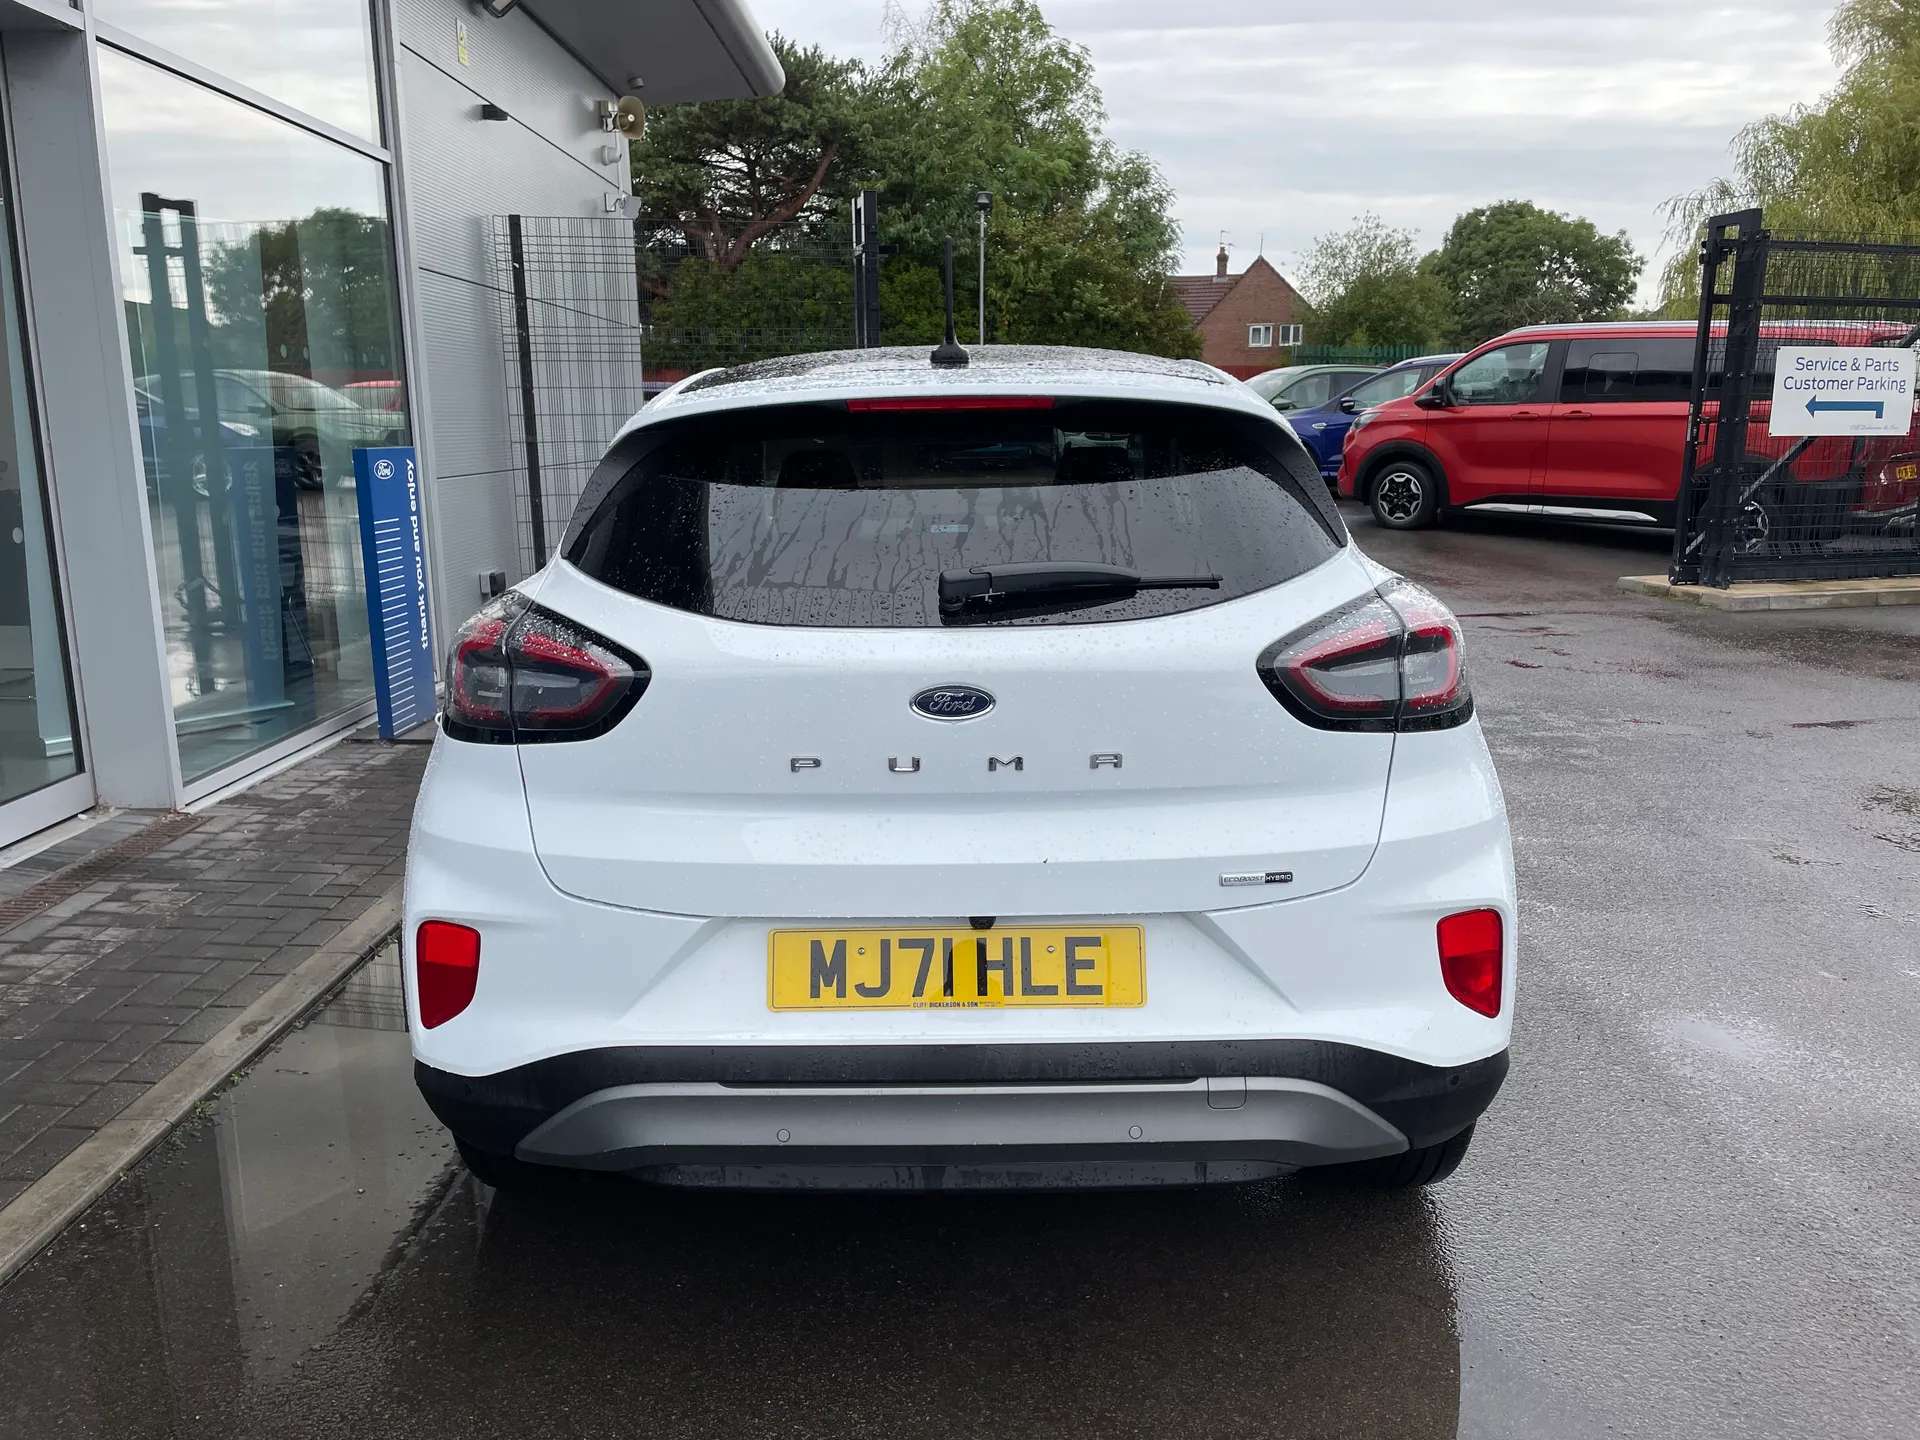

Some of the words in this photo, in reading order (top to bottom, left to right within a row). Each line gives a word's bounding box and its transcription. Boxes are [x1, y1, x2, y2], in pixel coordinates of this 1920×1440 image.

[1795, 357, 1847, 371] Service
[1851, 357, 1860, 371] &
[1865, 358, 1899, 372] Parts
[1783, 376, 1853, 391] Customer
[1857, 376, 1906, 394] Parking
[406, 459, 417, 512] enjoy
[410, 515, 421, 552] and
[415, 556, 425, 591] you
[417, 594, 428, 650] thank
[929, 692, 977, 711] Ford
[790, 753, 1123, 774] PUMA
[1265, 873, 1292, 882] HYBRID
[810, 938, 954, 998] MJ71
[976, 936, 1104, 997] HLE
